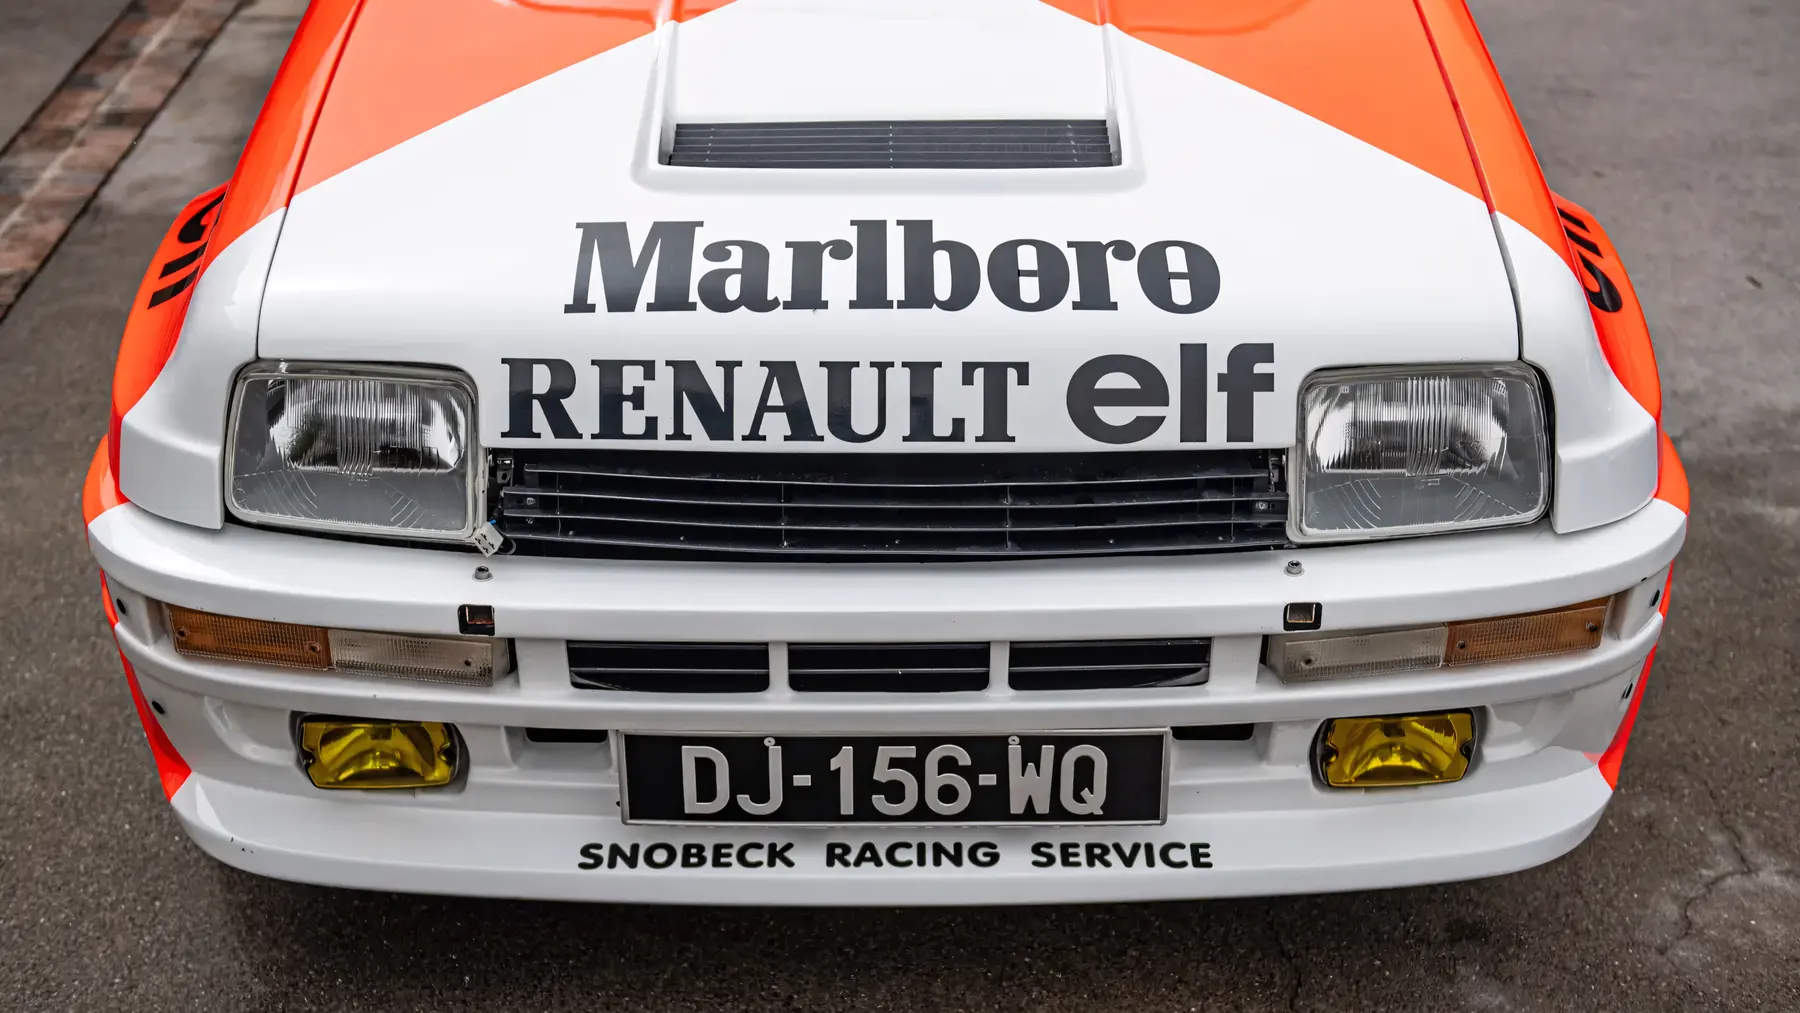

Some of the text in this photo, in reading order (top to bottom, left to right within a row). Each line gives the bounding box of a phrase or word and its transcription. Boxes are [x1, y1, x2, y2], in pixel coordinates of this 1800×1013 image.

[564, 220, 1220, 314] Marlboro
[501, 343, 1274, 444] RENAULT elf
[682, 745, 1108, 815] DJ-156-WQ
[578, 841, 1213, 869] SNOBECK RACING SERVICE
